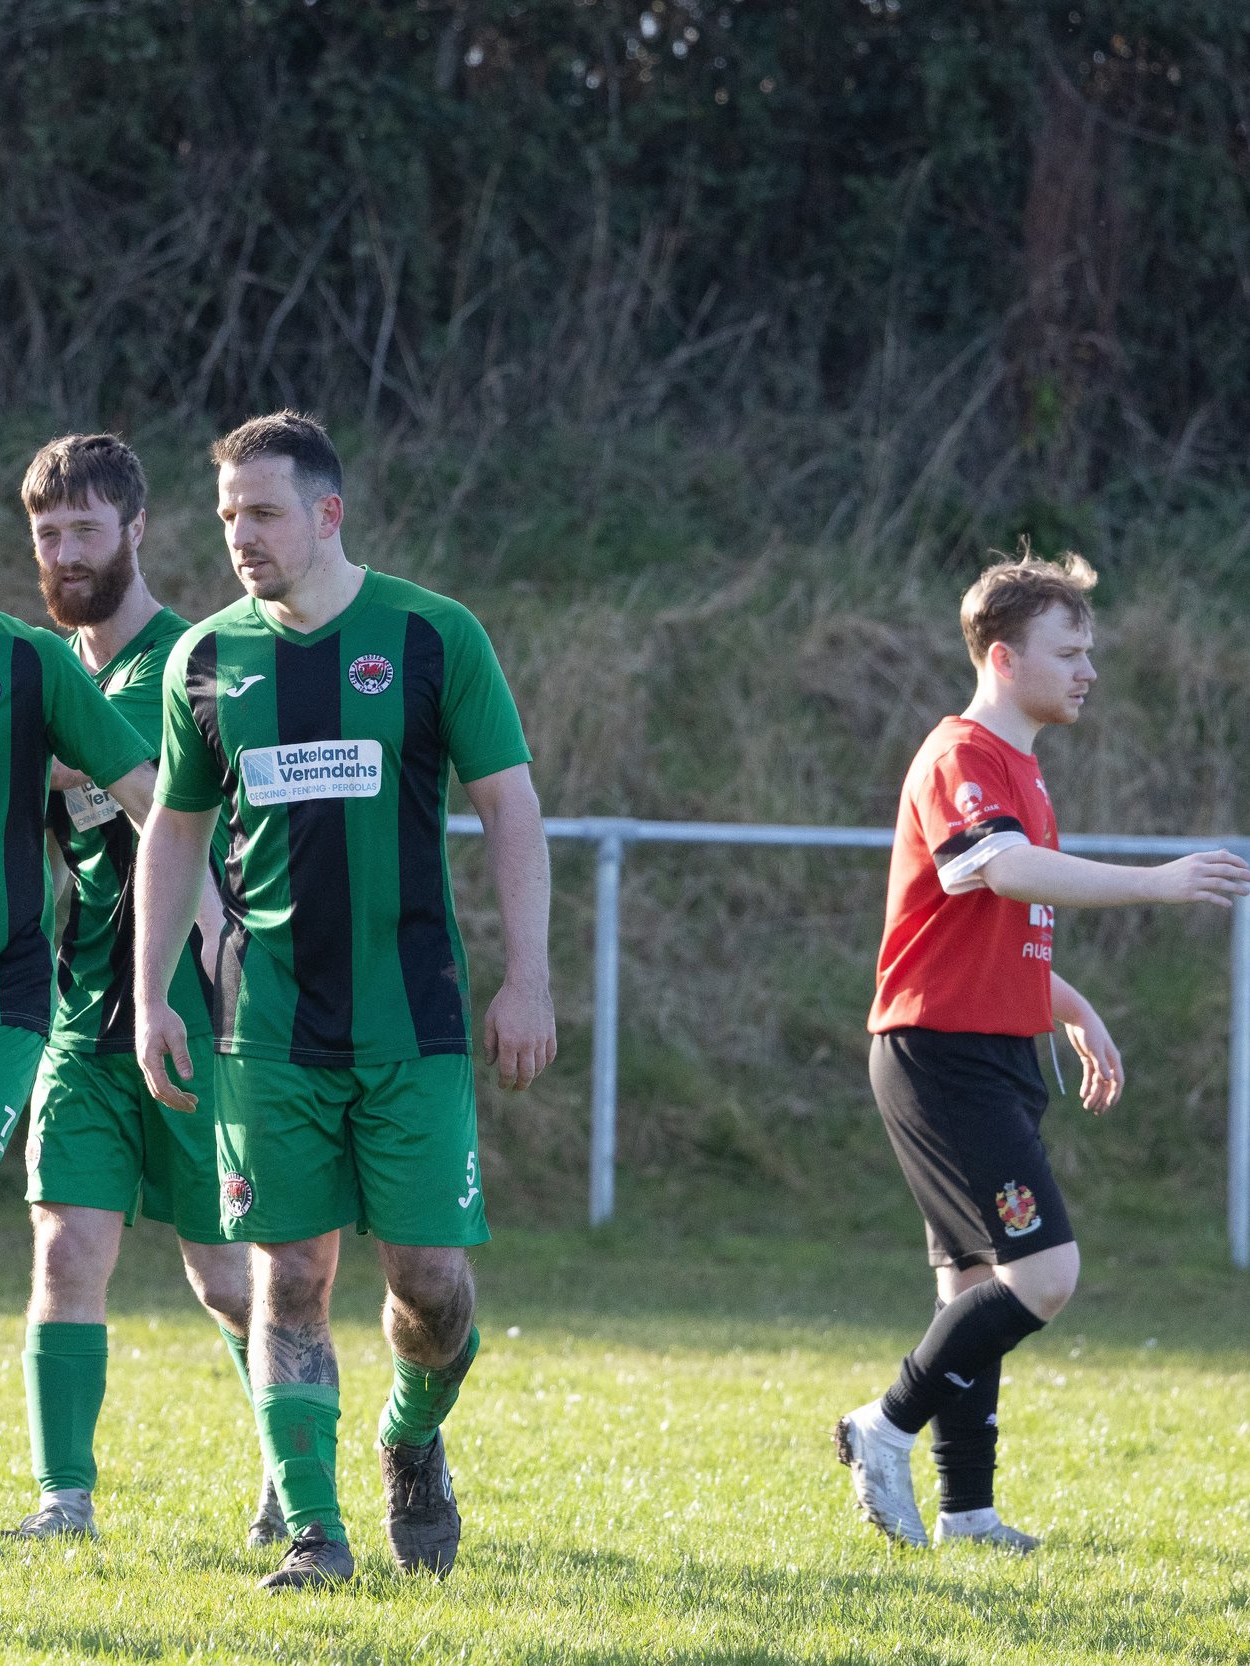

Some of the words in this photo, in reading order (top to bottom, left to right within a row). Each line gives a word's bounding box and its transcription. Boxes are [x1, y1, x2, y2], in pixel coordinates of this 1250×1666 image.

[276, 745, 359, 766] Lakeland
[279, 763, 377, 782] Verandahs
[249, 788, 287, 801] DECKING
[332, 783, 377, 792] PERGOLAS
[0, 1104, 16, 1138] 7
[466, 1151, 475, 1185] 5
